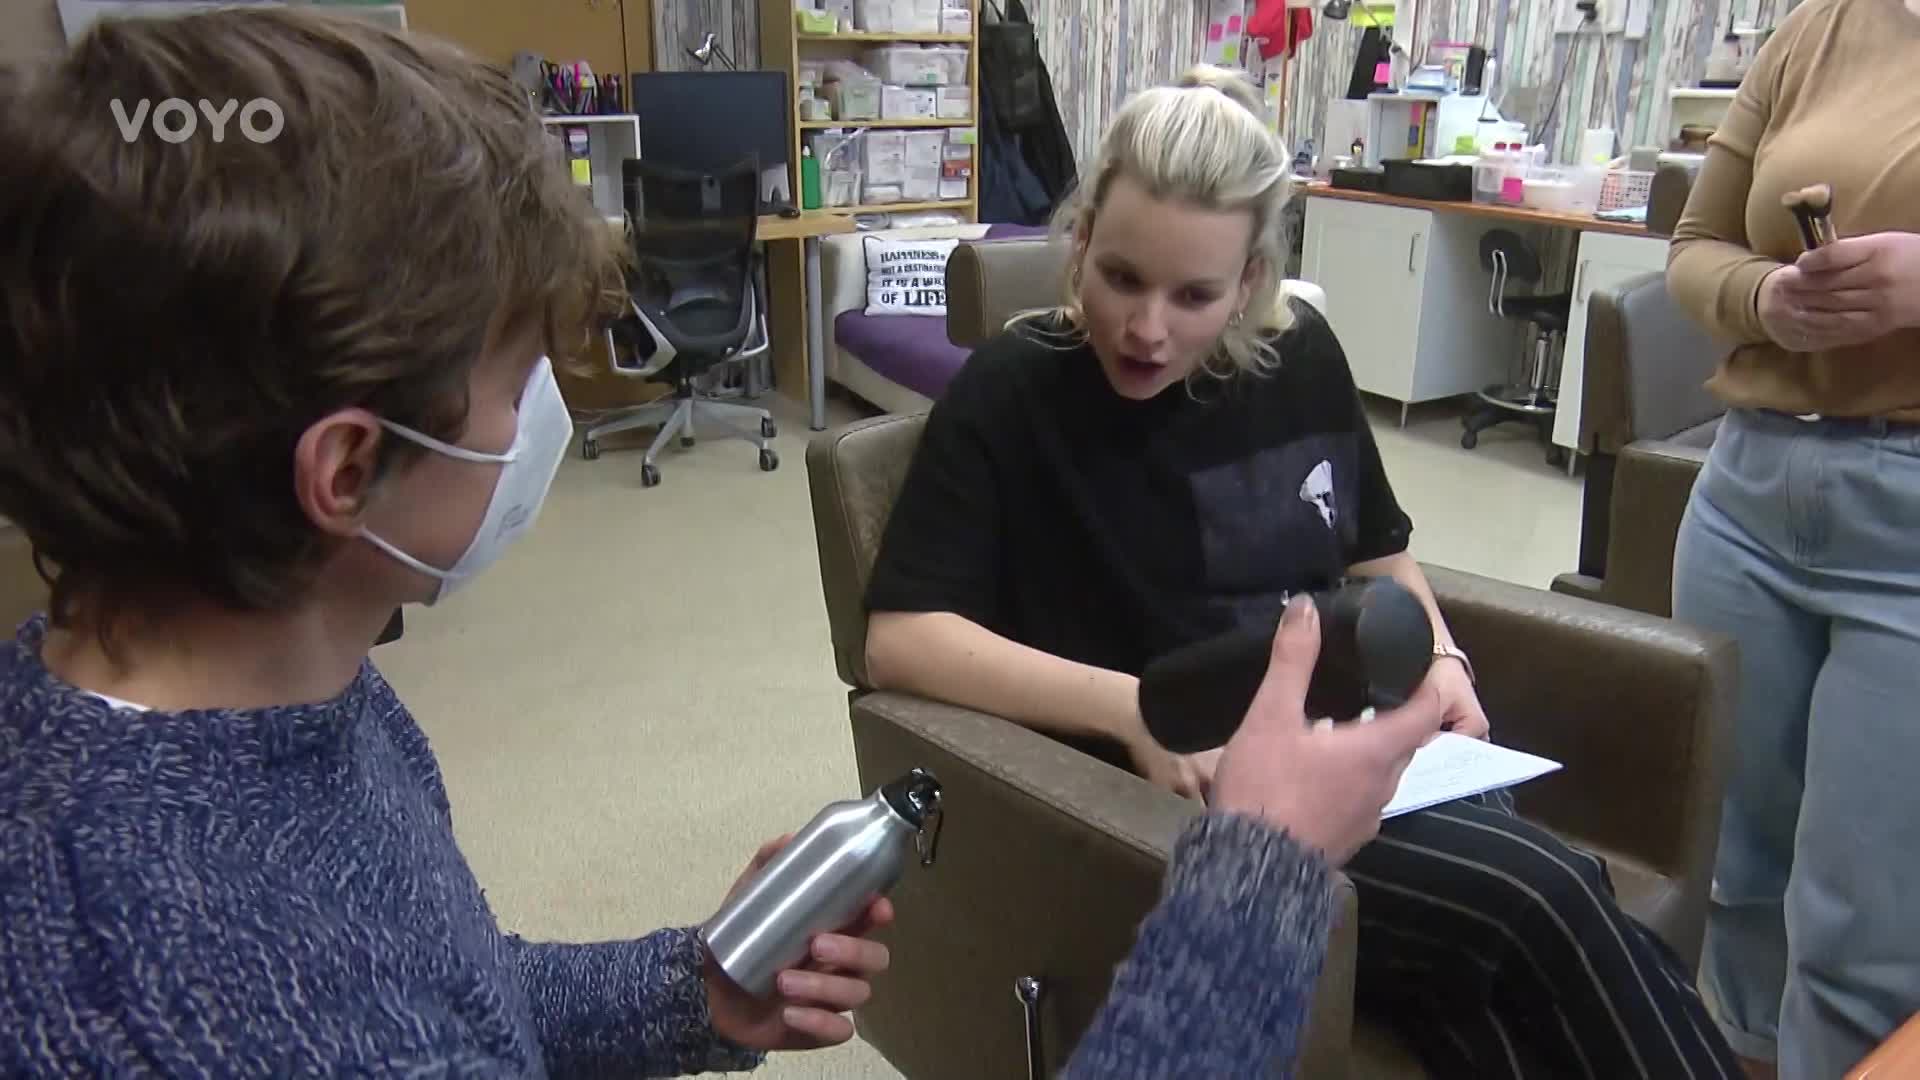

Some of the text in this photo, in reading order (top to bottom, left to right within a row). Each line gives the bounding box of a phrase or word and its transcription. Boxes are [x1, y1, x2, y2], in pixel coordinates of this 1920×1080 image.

[912, 277, 919, 288] A
[881, 289, 946, 306] OF LIFE
